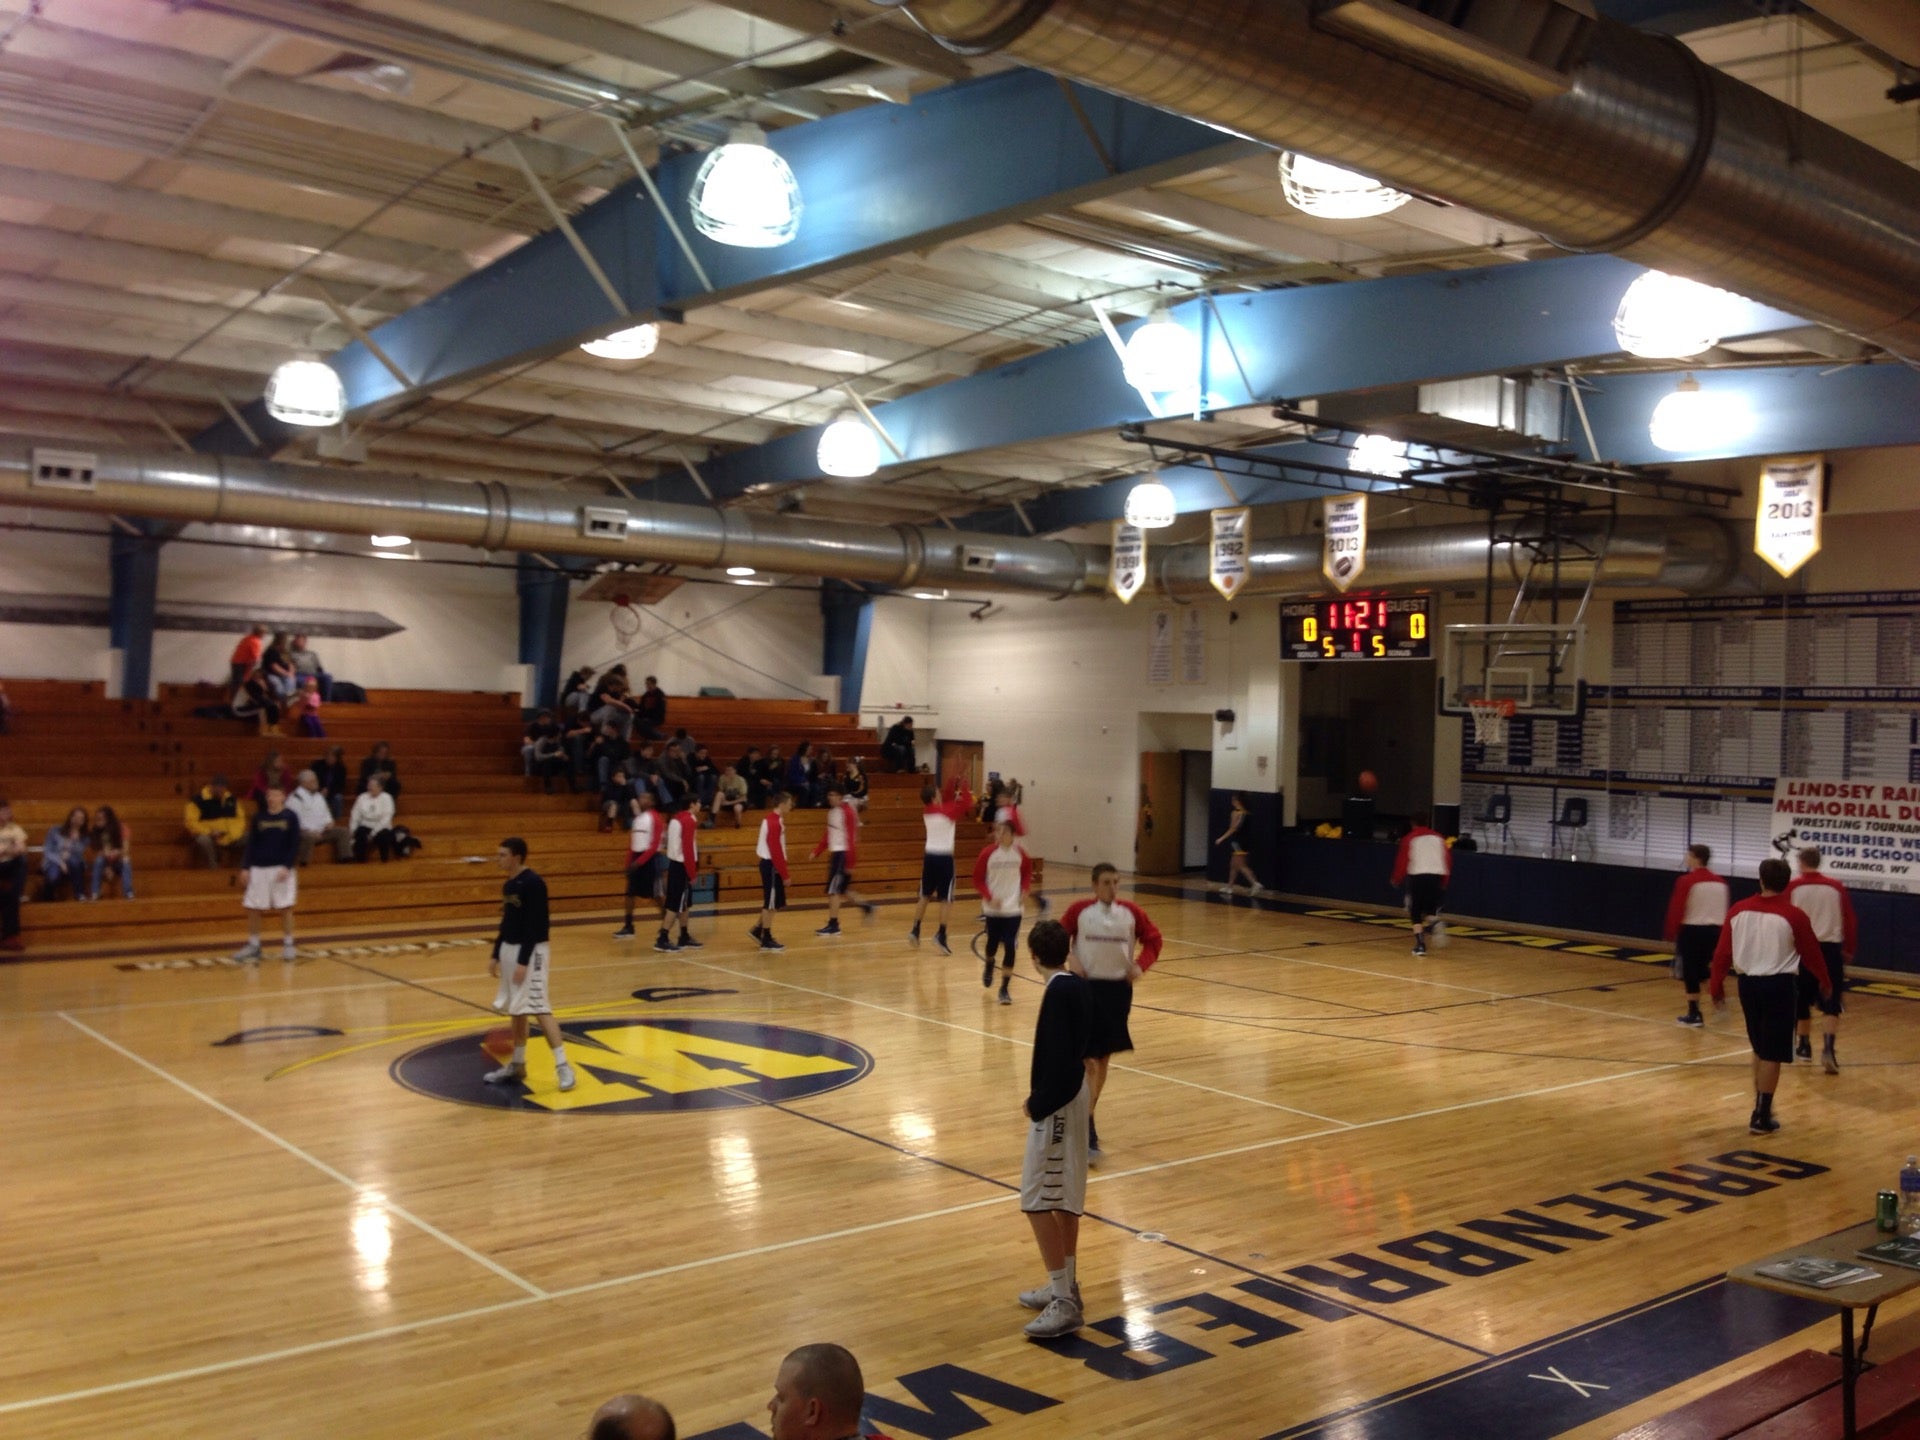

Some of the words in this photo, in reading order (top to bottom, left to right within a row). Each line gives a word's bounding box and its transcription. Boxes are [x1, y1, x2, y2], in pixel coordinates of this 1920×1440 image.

[1768, 501, 1813, 519] 2013
[1328, 537, 1358, 553] 2013
[1283, 604, 1316, 616] HOME
[1329, 601, 1387, 630] 11:21
[1386, 600, 1426, 612] GUEST
[1303, 617, 1317, 642] 0
[1410, 613, 1426, 639] 0
[1322, 635, 1336, 657] 5
[1353, 632, 1361, 652] 1
[1371, 635, 1385, 657] 5
[1787, 782, 1875, 799] LINDSEY
[1882, 786, 1920, 802] RAI
[1775, 799, 1891, 819] MEMORIAL
[1792, 817, 1861, 830] WRESTLING
[1800, 831, 1895, 847] GREENBRIER
[1816, 844, 1856, 857] HIGH
[1861, 848, 1920, 863] SCHOOL
[1890, 865, 1909, 874] WV
[1052, 1114, 1065, 1146] WEST
[1027, 1150, 1832, 1382] GREENBRIER
